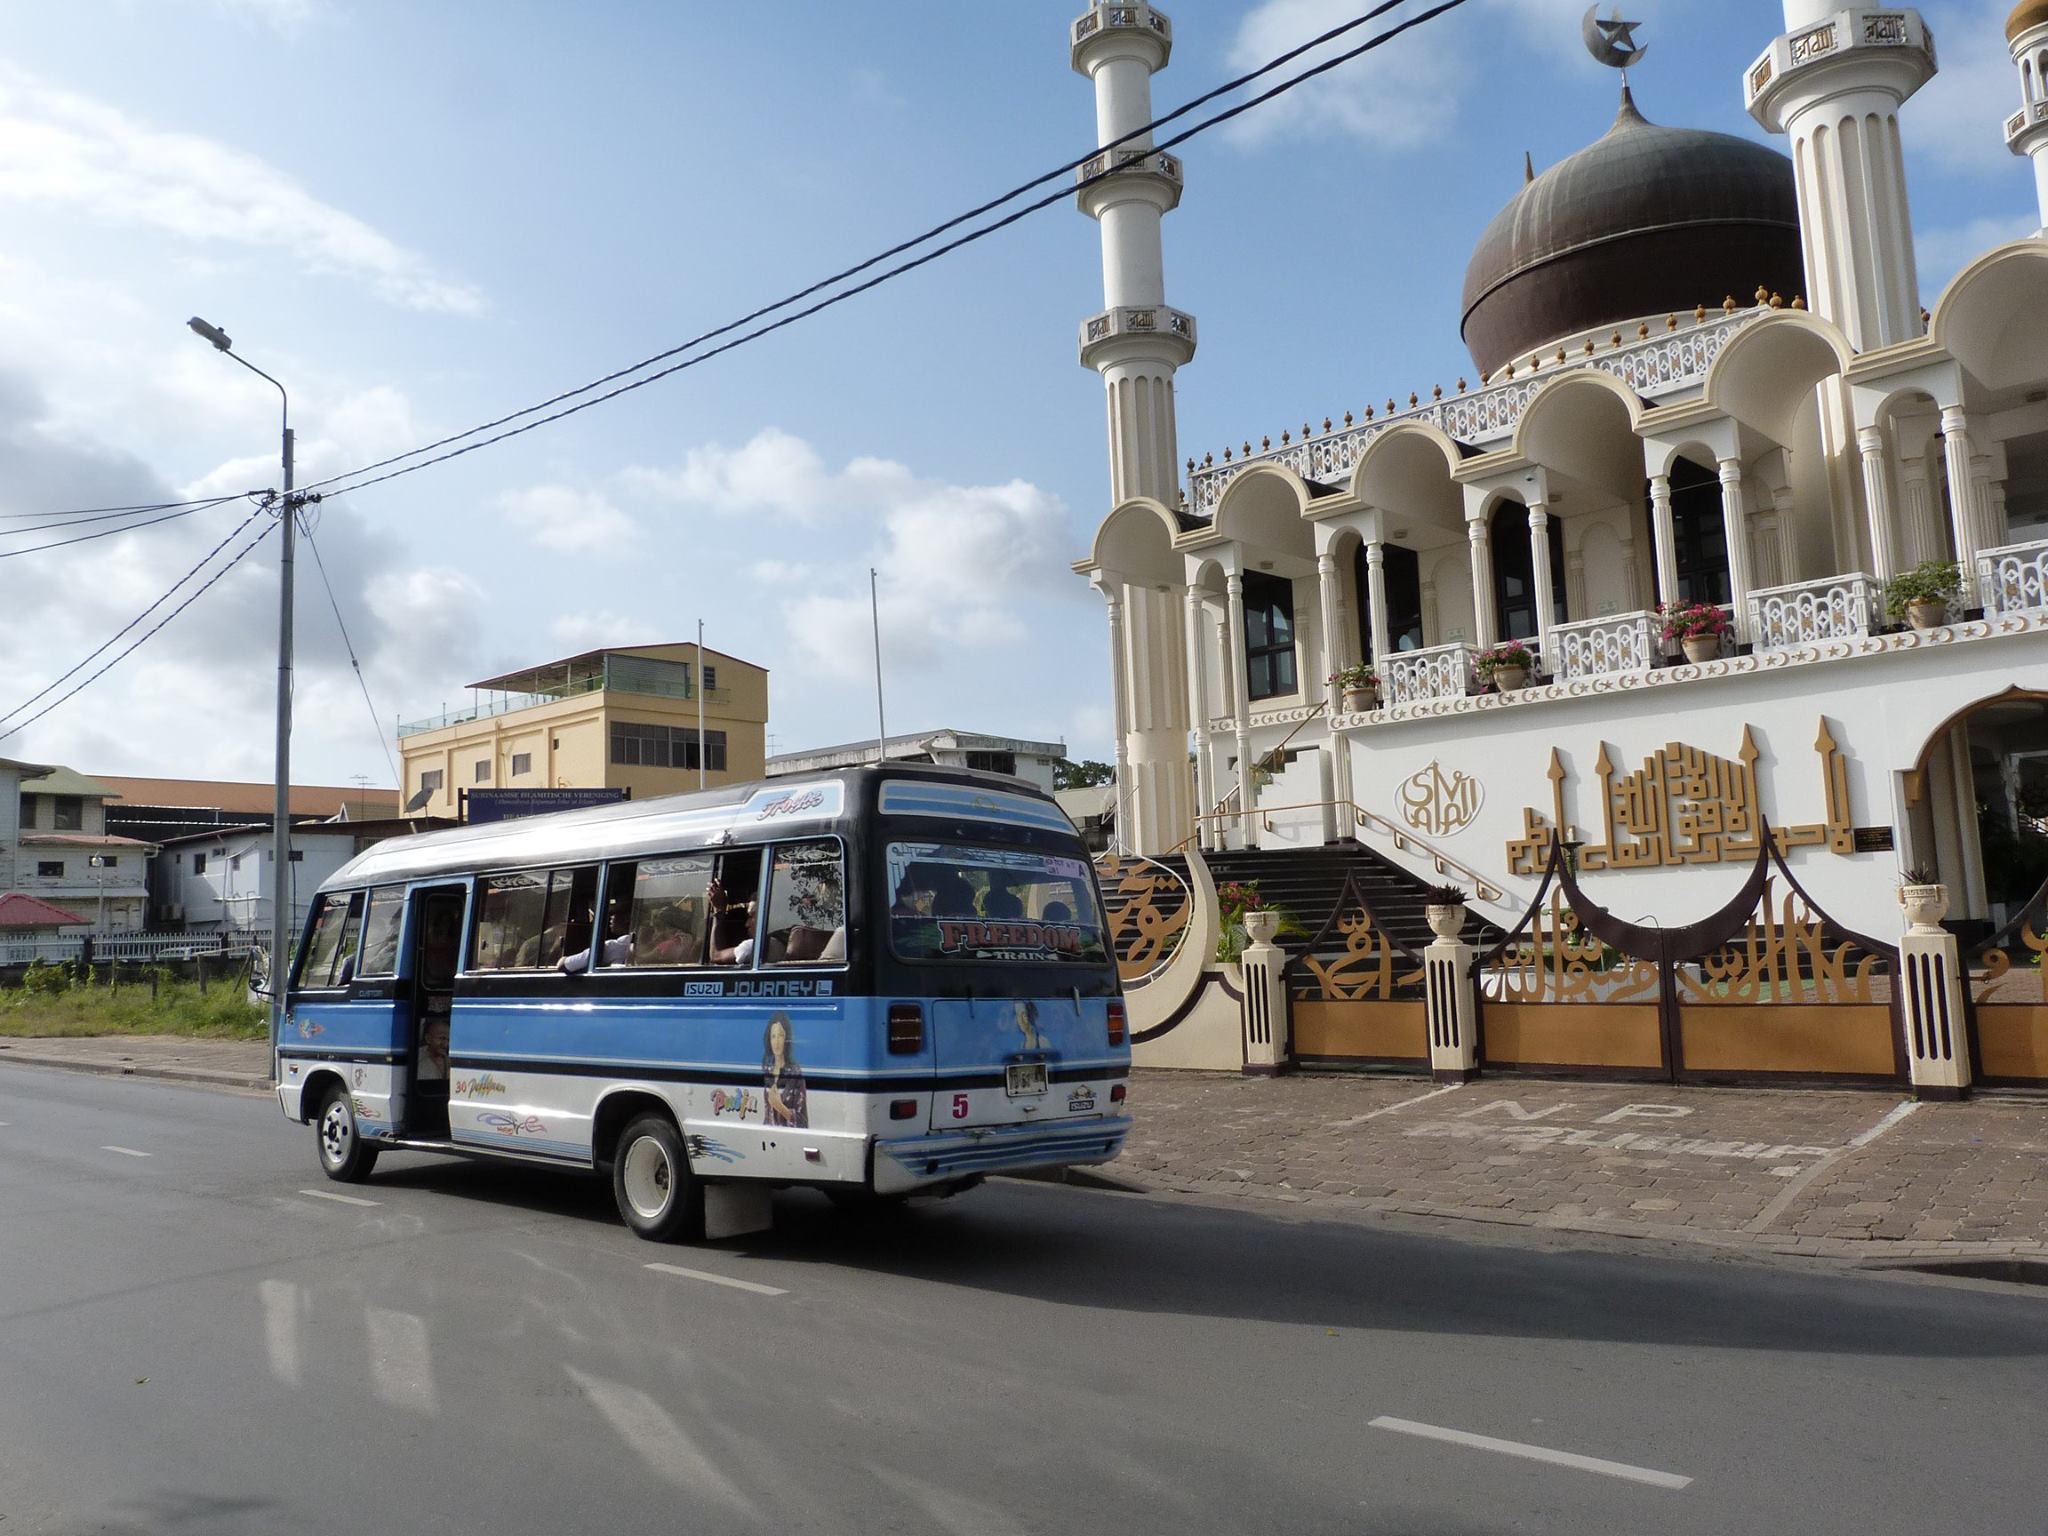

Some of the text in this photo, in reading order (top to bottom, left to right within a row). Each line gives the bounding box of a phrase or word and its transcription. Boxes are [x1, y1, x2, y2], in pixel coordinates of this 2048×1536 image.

[938, 921, 1084, 958] FREEDOM
[995, 950, 1045, 962] TRAIN
[686, 982, 722, 995] ISUZU
[726, 980, 813, 997] JOURNEY
[952, 1093, 969, 1119] 5
